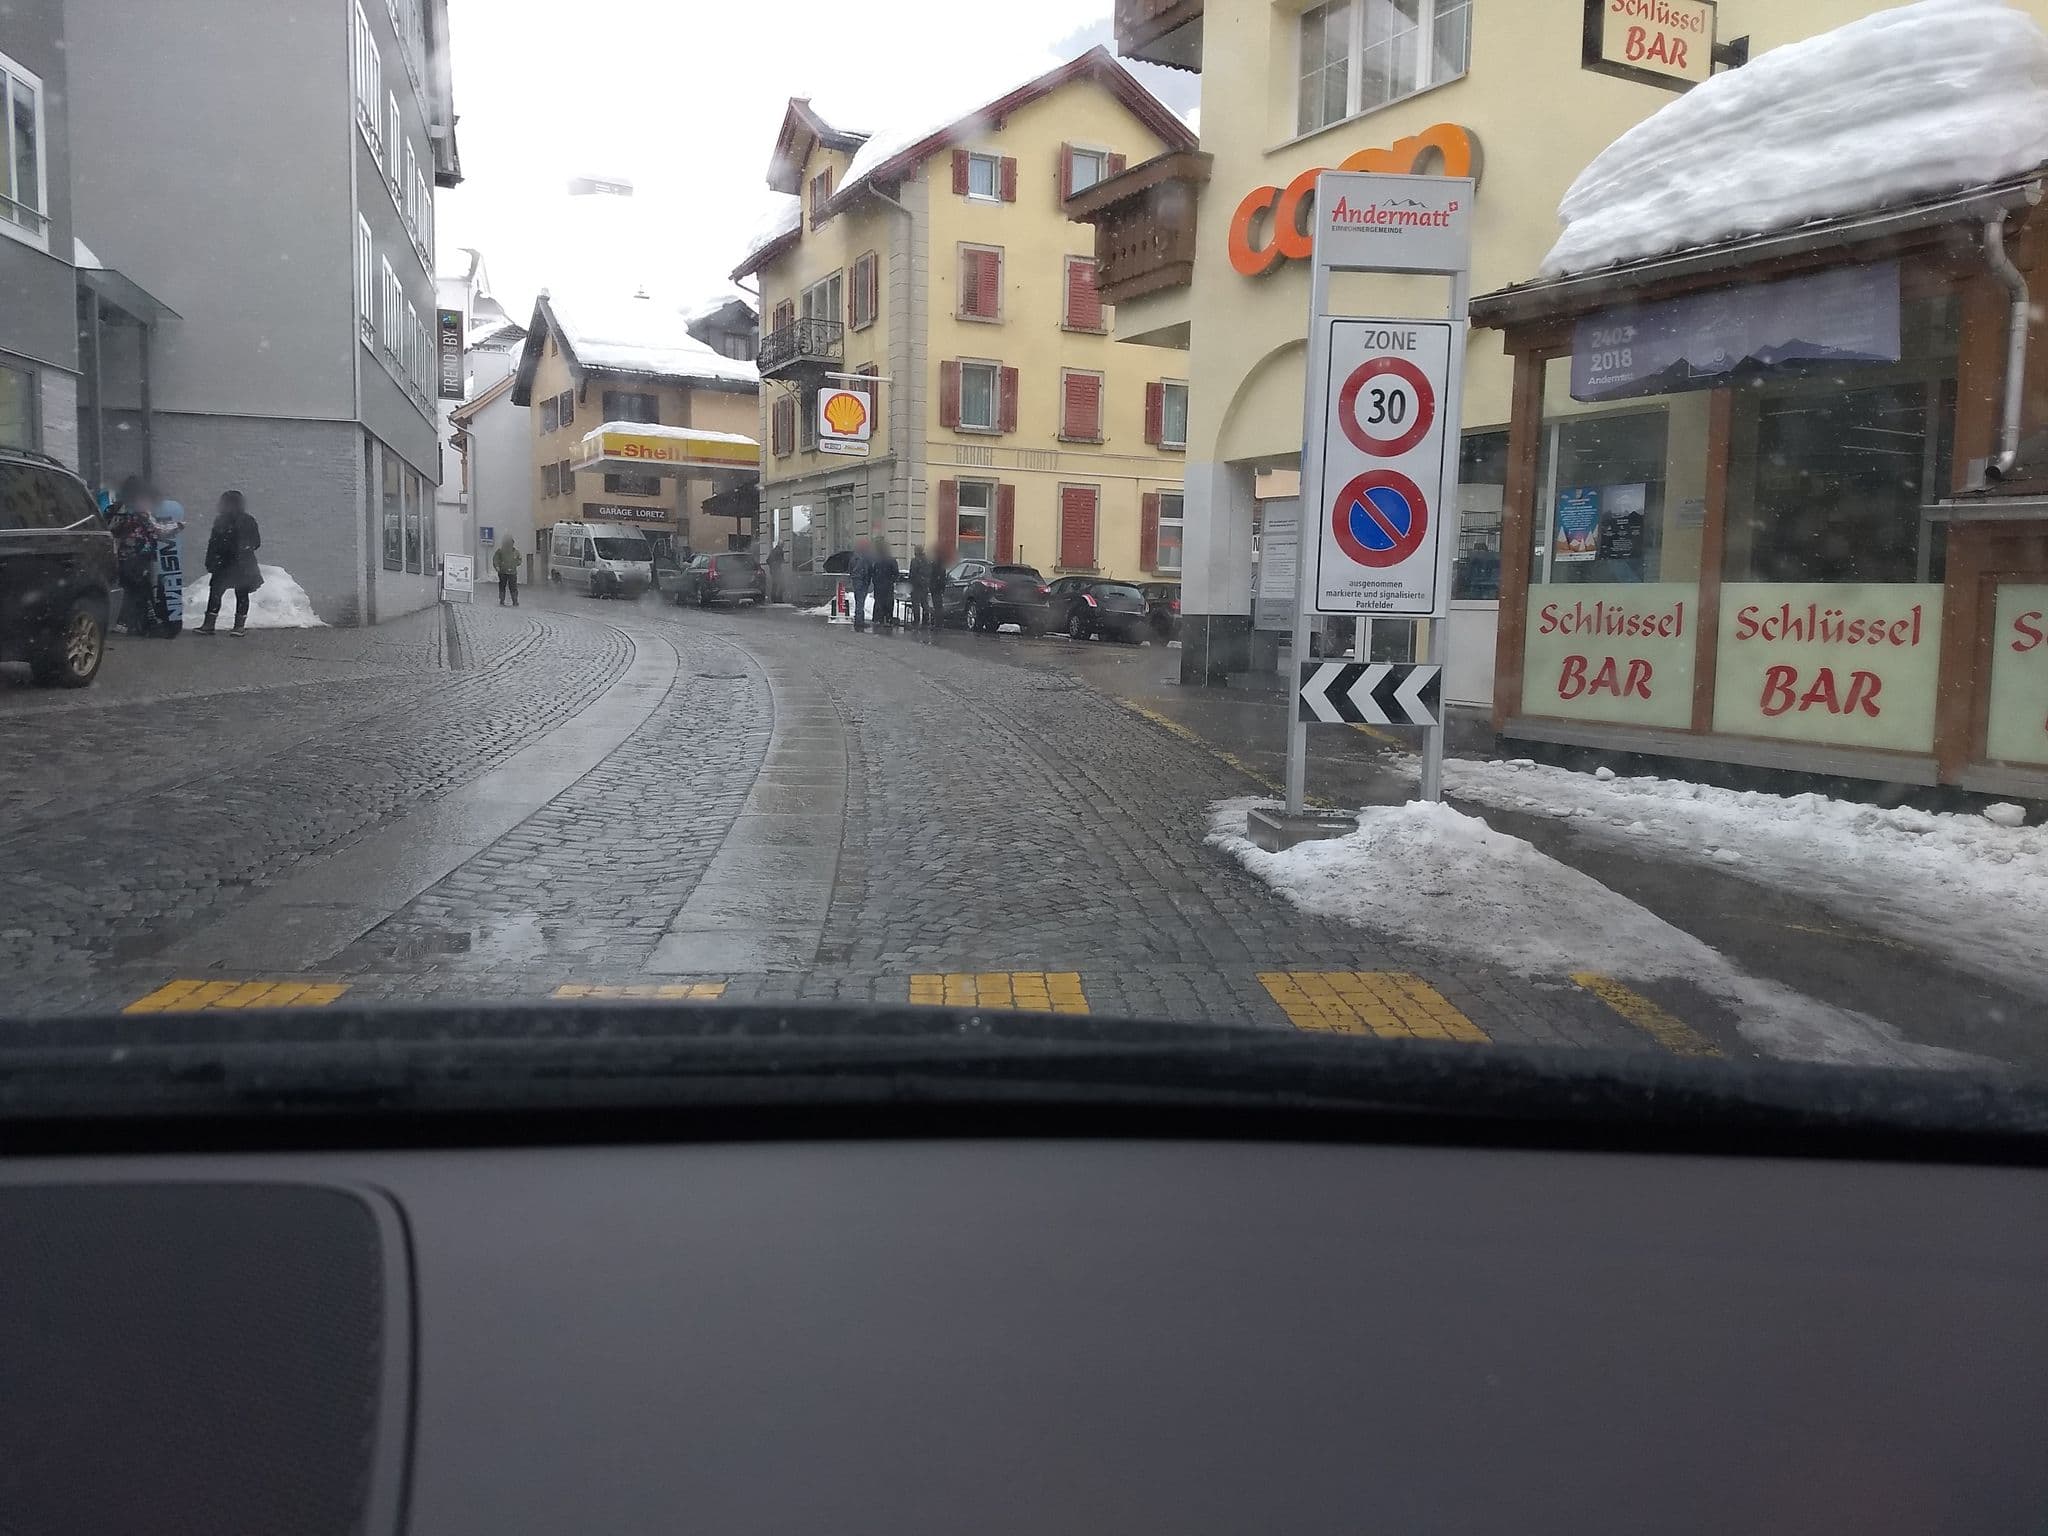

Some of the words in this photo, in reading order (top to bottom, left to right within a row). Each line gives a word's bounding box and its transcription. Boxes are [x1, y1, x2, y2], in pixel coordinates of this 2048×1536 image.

[1625, 25, 1688, 69] BAR
[1332, 195, 1450, 227] Andermatt
[1364, 330, 1417, 350] ZONE
[443, 354, 459, 393] TREND
[1590, 348, 1633, 372] 2018
[1367, 388, 1407, 424] 30
[623, 443, 679, 461] Shell
[600, 507, 633, 517] GARAGE
[636, 510, 665, 519] LORETZ
[1325, 589, 1362, 598] markierte
[1379, 591, 1426, 600] signalisierte
[1349, 580, 1403, 588] ausgenommen
[1355, 600, 1394, 609] Parkfelder
[1539, 600, 1684, 638] Schlüssel
[1735, 603, 1922, 647] Schlüssel
[1558, 655, 1653, 700] BAR
[1760, 665, 1882, 718] BAR
